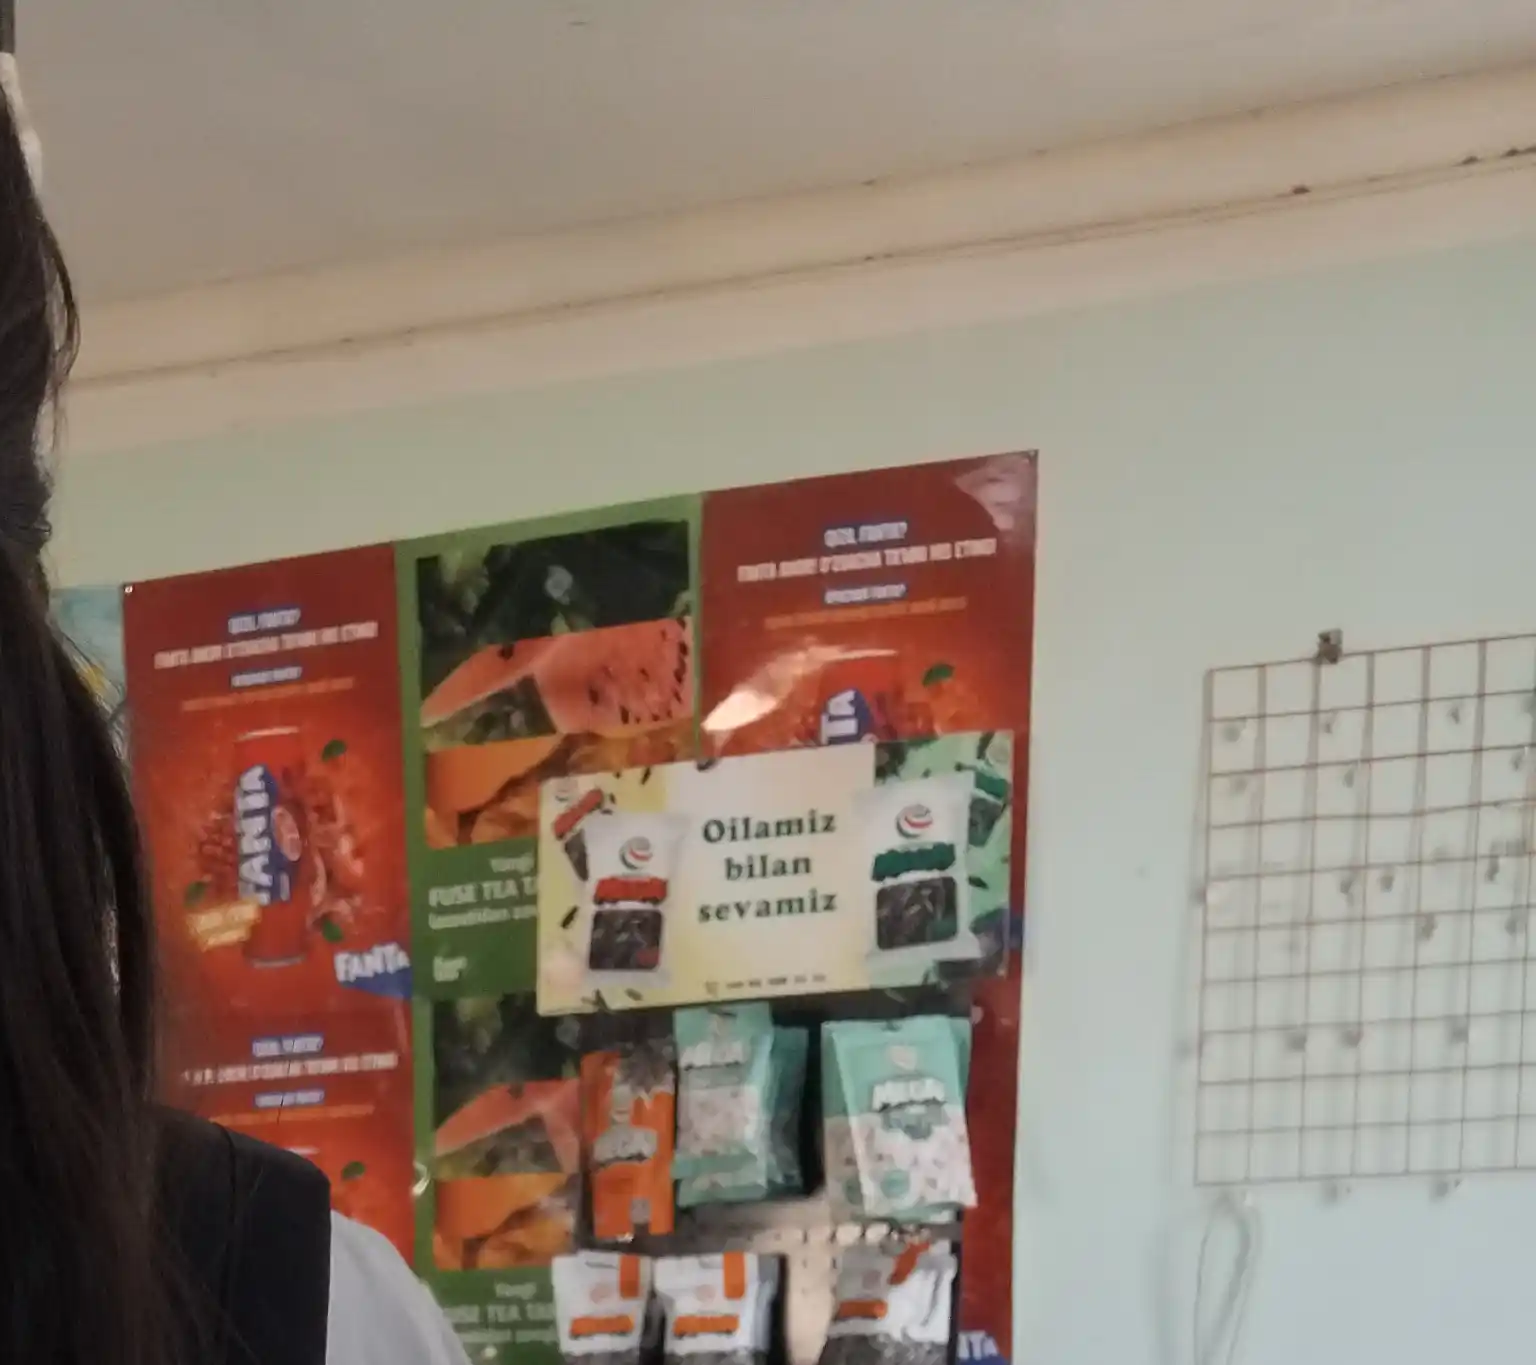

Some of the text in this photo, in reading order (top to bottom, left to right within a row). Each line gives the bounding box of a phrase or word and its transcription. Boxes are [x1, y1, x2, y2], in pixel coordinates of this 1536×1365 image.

[702, 809, 836, 843] Oilamiz
[724, 854, 812, 881] bilan
[698, 888, 837, 922] sevamiz
